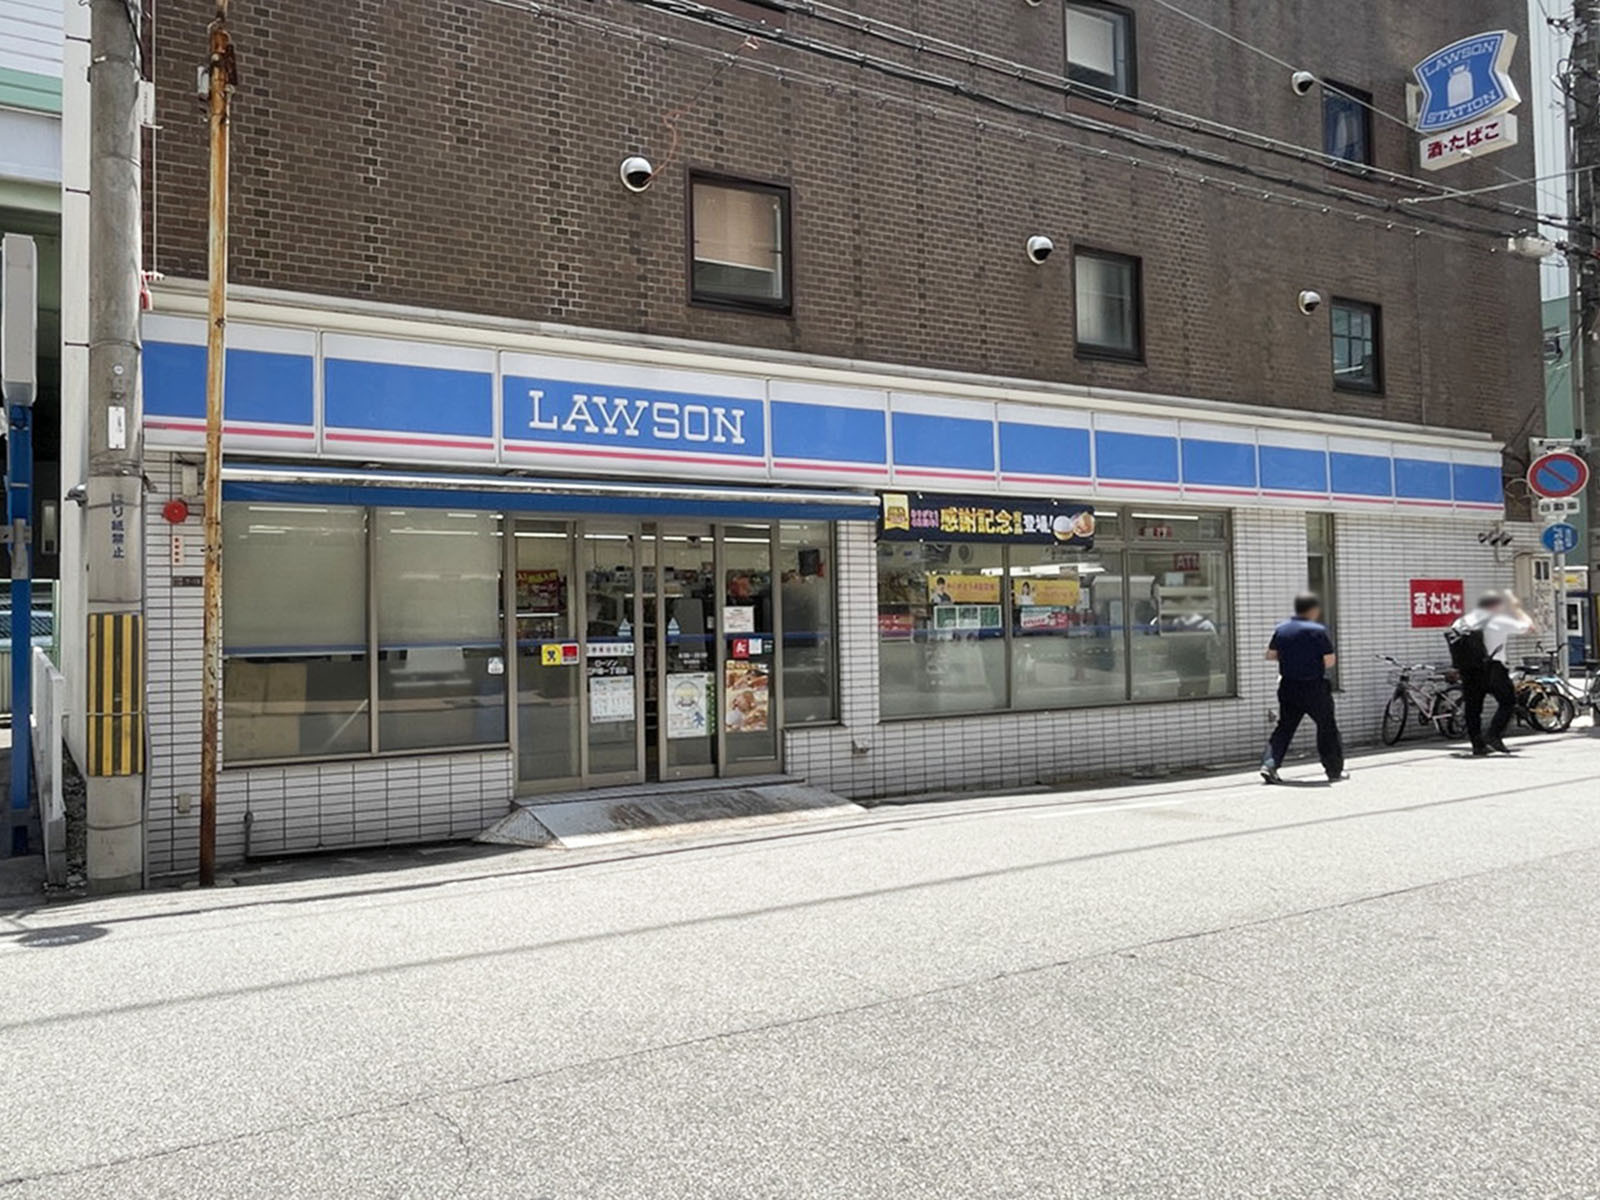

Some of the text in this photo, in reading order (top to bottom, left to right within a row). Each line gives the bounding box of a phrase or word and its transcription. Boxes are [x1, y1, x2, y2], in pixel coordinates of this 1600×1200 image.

[1424, 40, 1496, 77] LAWSON
[1426, 90, 1498, 123] STATION
[1427, 122, 1500, 160] 酒・たばこ
[528, 389, 745, 445] LAWSON
[111, 492, 125, 559] はり紙禁止
[1413, 591, 1463, 615] 酒・たばこ
